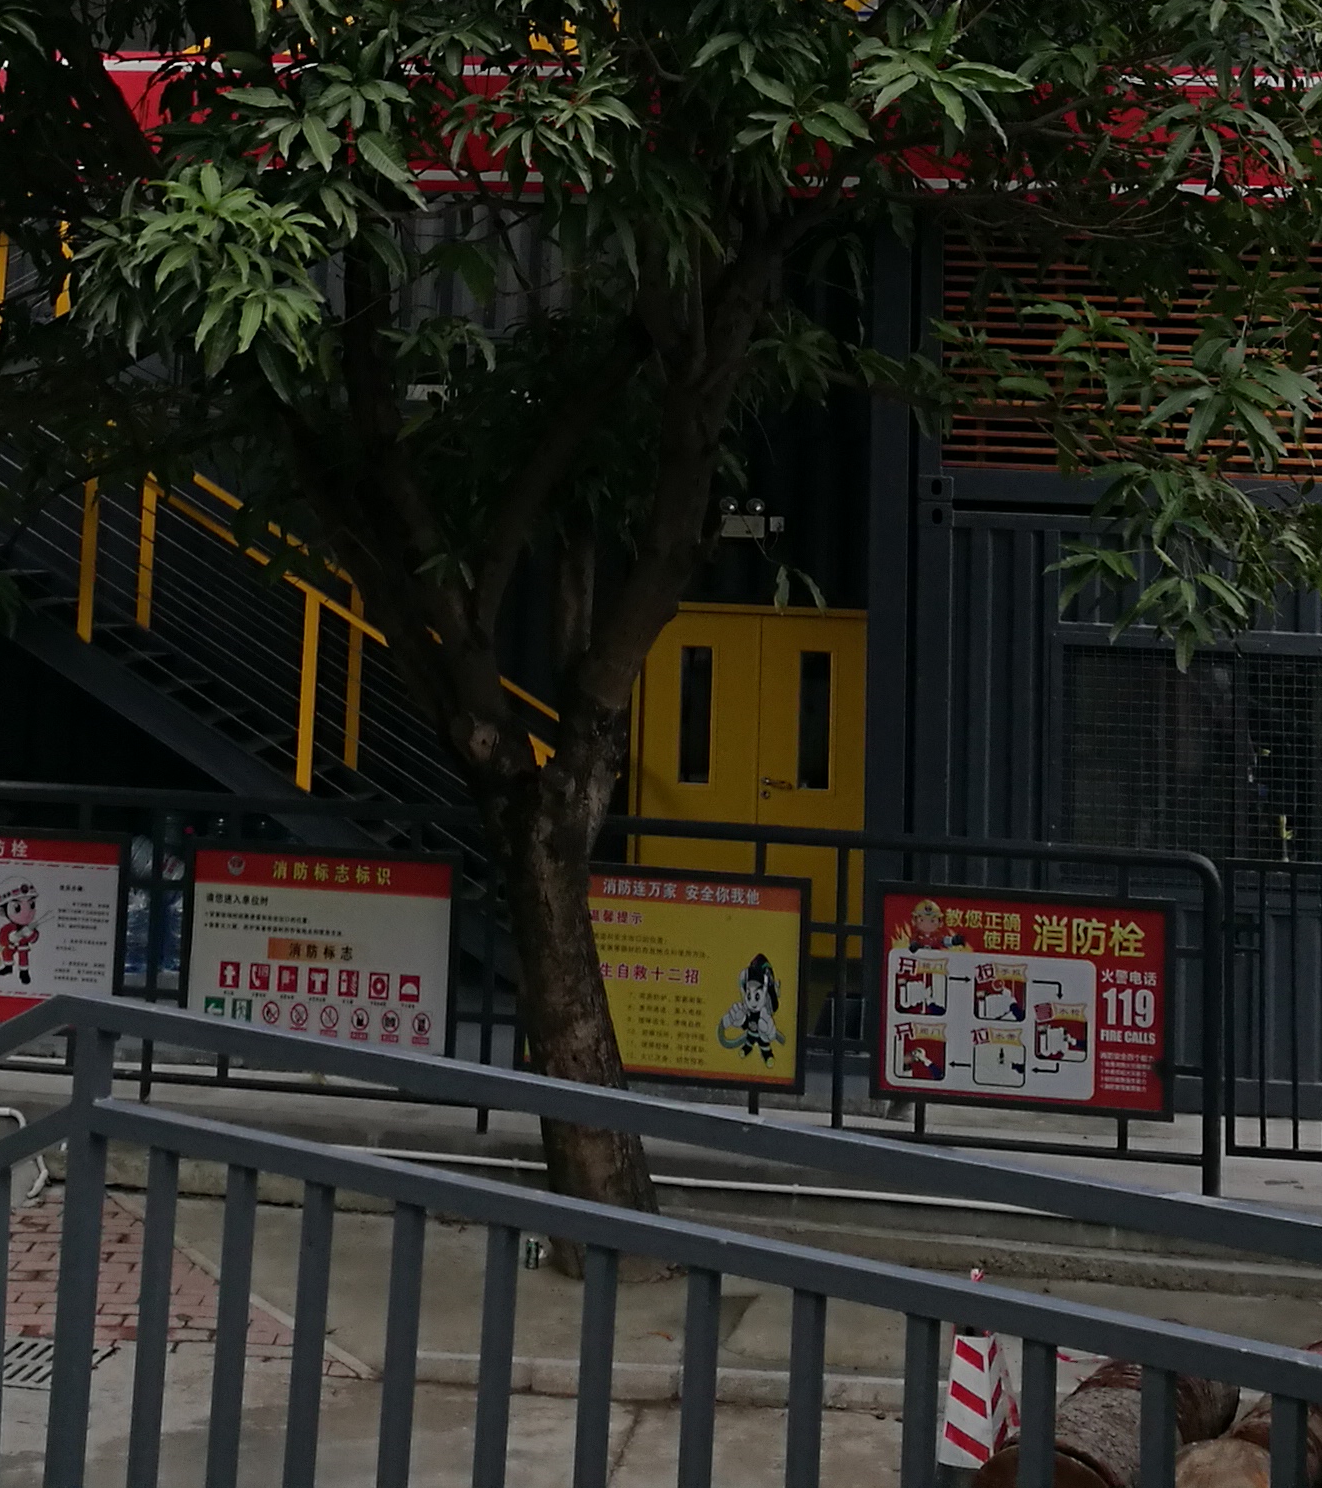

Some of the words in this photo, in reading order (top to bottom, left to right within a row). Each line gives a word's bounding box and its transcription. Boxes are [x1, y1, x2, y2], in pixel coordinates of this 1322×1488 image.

[272, 861, 391, 886] 消防标志标识
[603, 878, 677, 899] 消防连万家
[685, 884, 760, 906] 安全你我他
[945, 908, 1021, 932] 教您正确
[983, 931, 1021, 951] 使用
[1033, 914, 1146, 958] 消防栓
[289, 942, 354, 961] 消防标志
[899, 957, 916, 975] 开
[1101, 969, 1158, 987] 火警电话
[1102, 988, 1155, 1028] 119
[895, 1022, 914, 1040] 开
[971, 1027, 990, 1044] 拉
[1100, 1029, 1123, 1042] FIRE
[1124, 1031, 1157, 1045] CALLS
